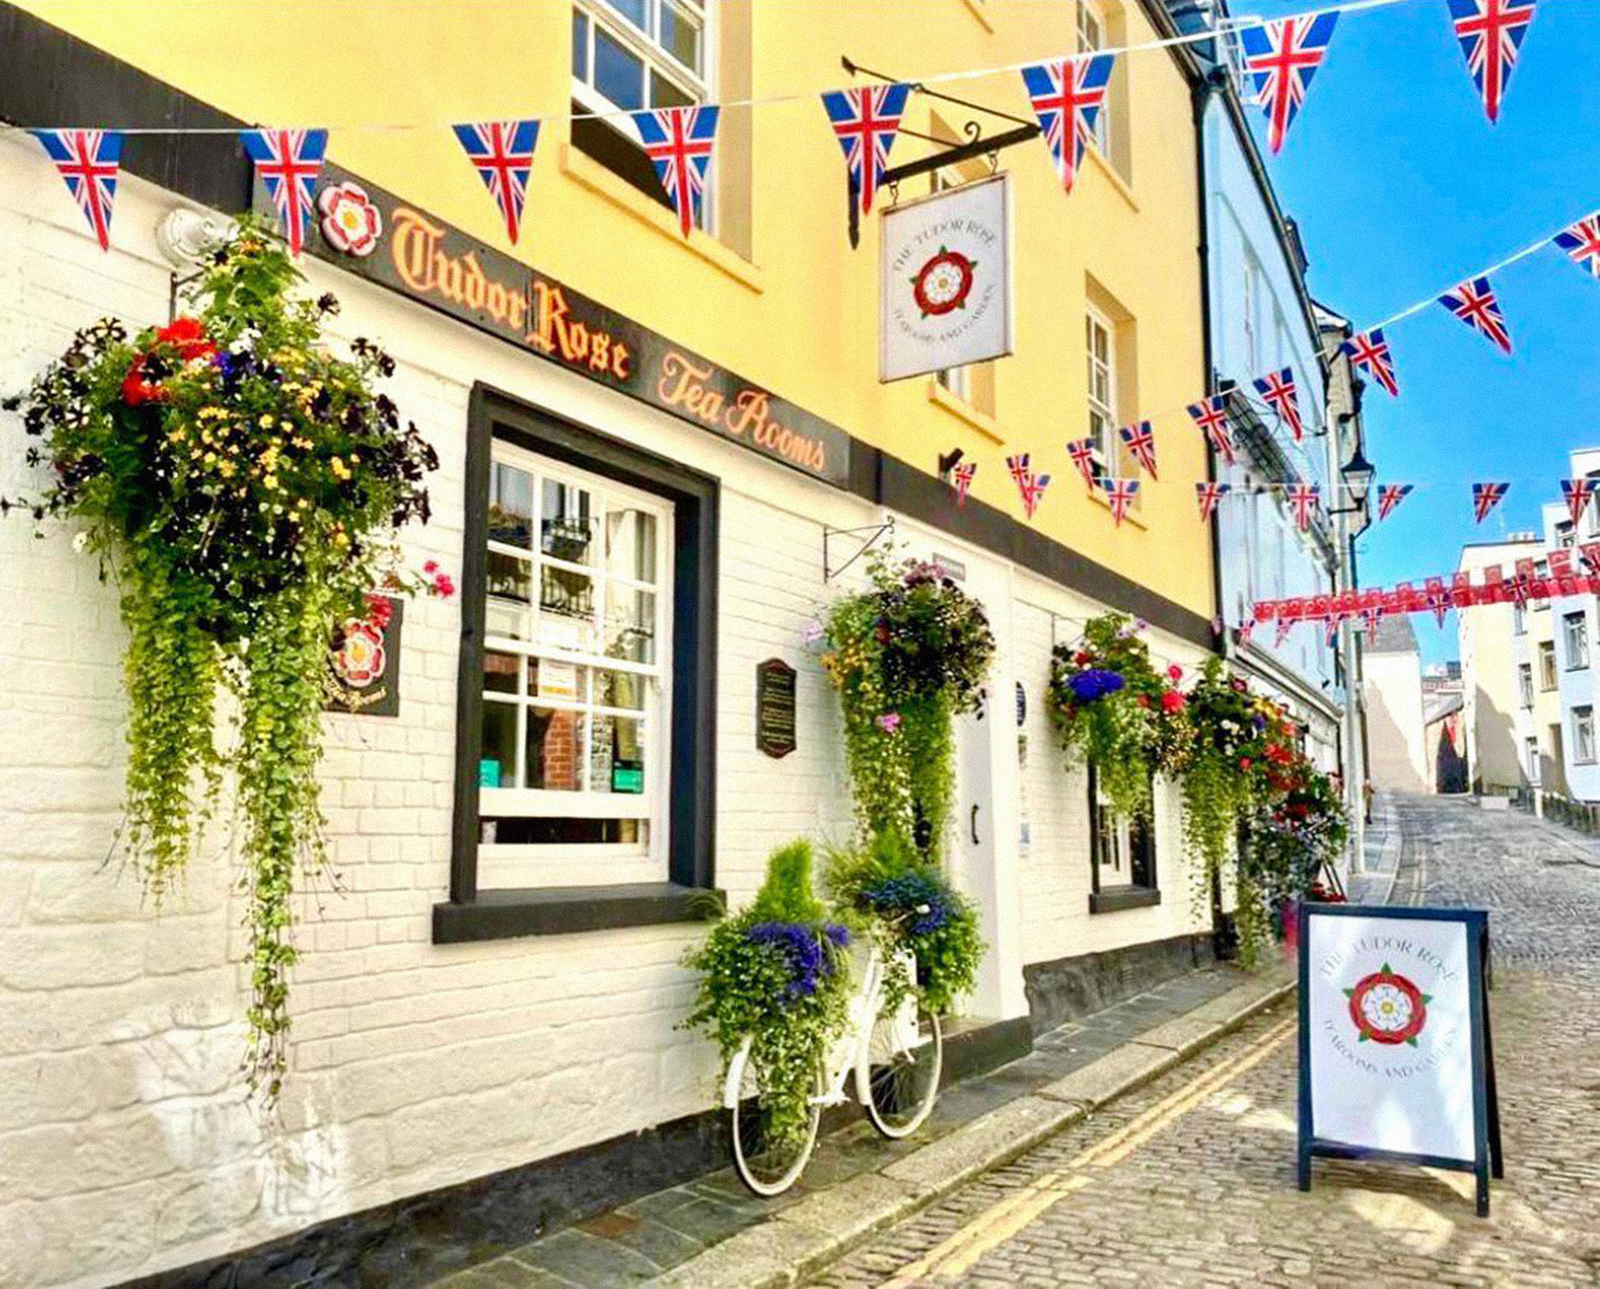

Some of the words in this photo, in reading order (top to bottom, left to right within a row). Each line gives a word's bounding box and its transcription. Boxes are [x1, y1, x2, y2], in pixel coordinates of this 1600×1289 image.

[893, 246, 911, 271] THE
[916, 220, 963, 243] TUDOR
[966, 220, 995, 247] ROSE
[392, 207, 528, 330] Tudor
[526, 280, 629, 378] Rose
[658, 351, 724, 422] Tea
[726, 390, 826, 471] Rooms
[1354, 937, 1412, 954] TUDOR
[1417, 947, 1456, 981] ROSE
[1385, 1065, 1413, 1078] AND
